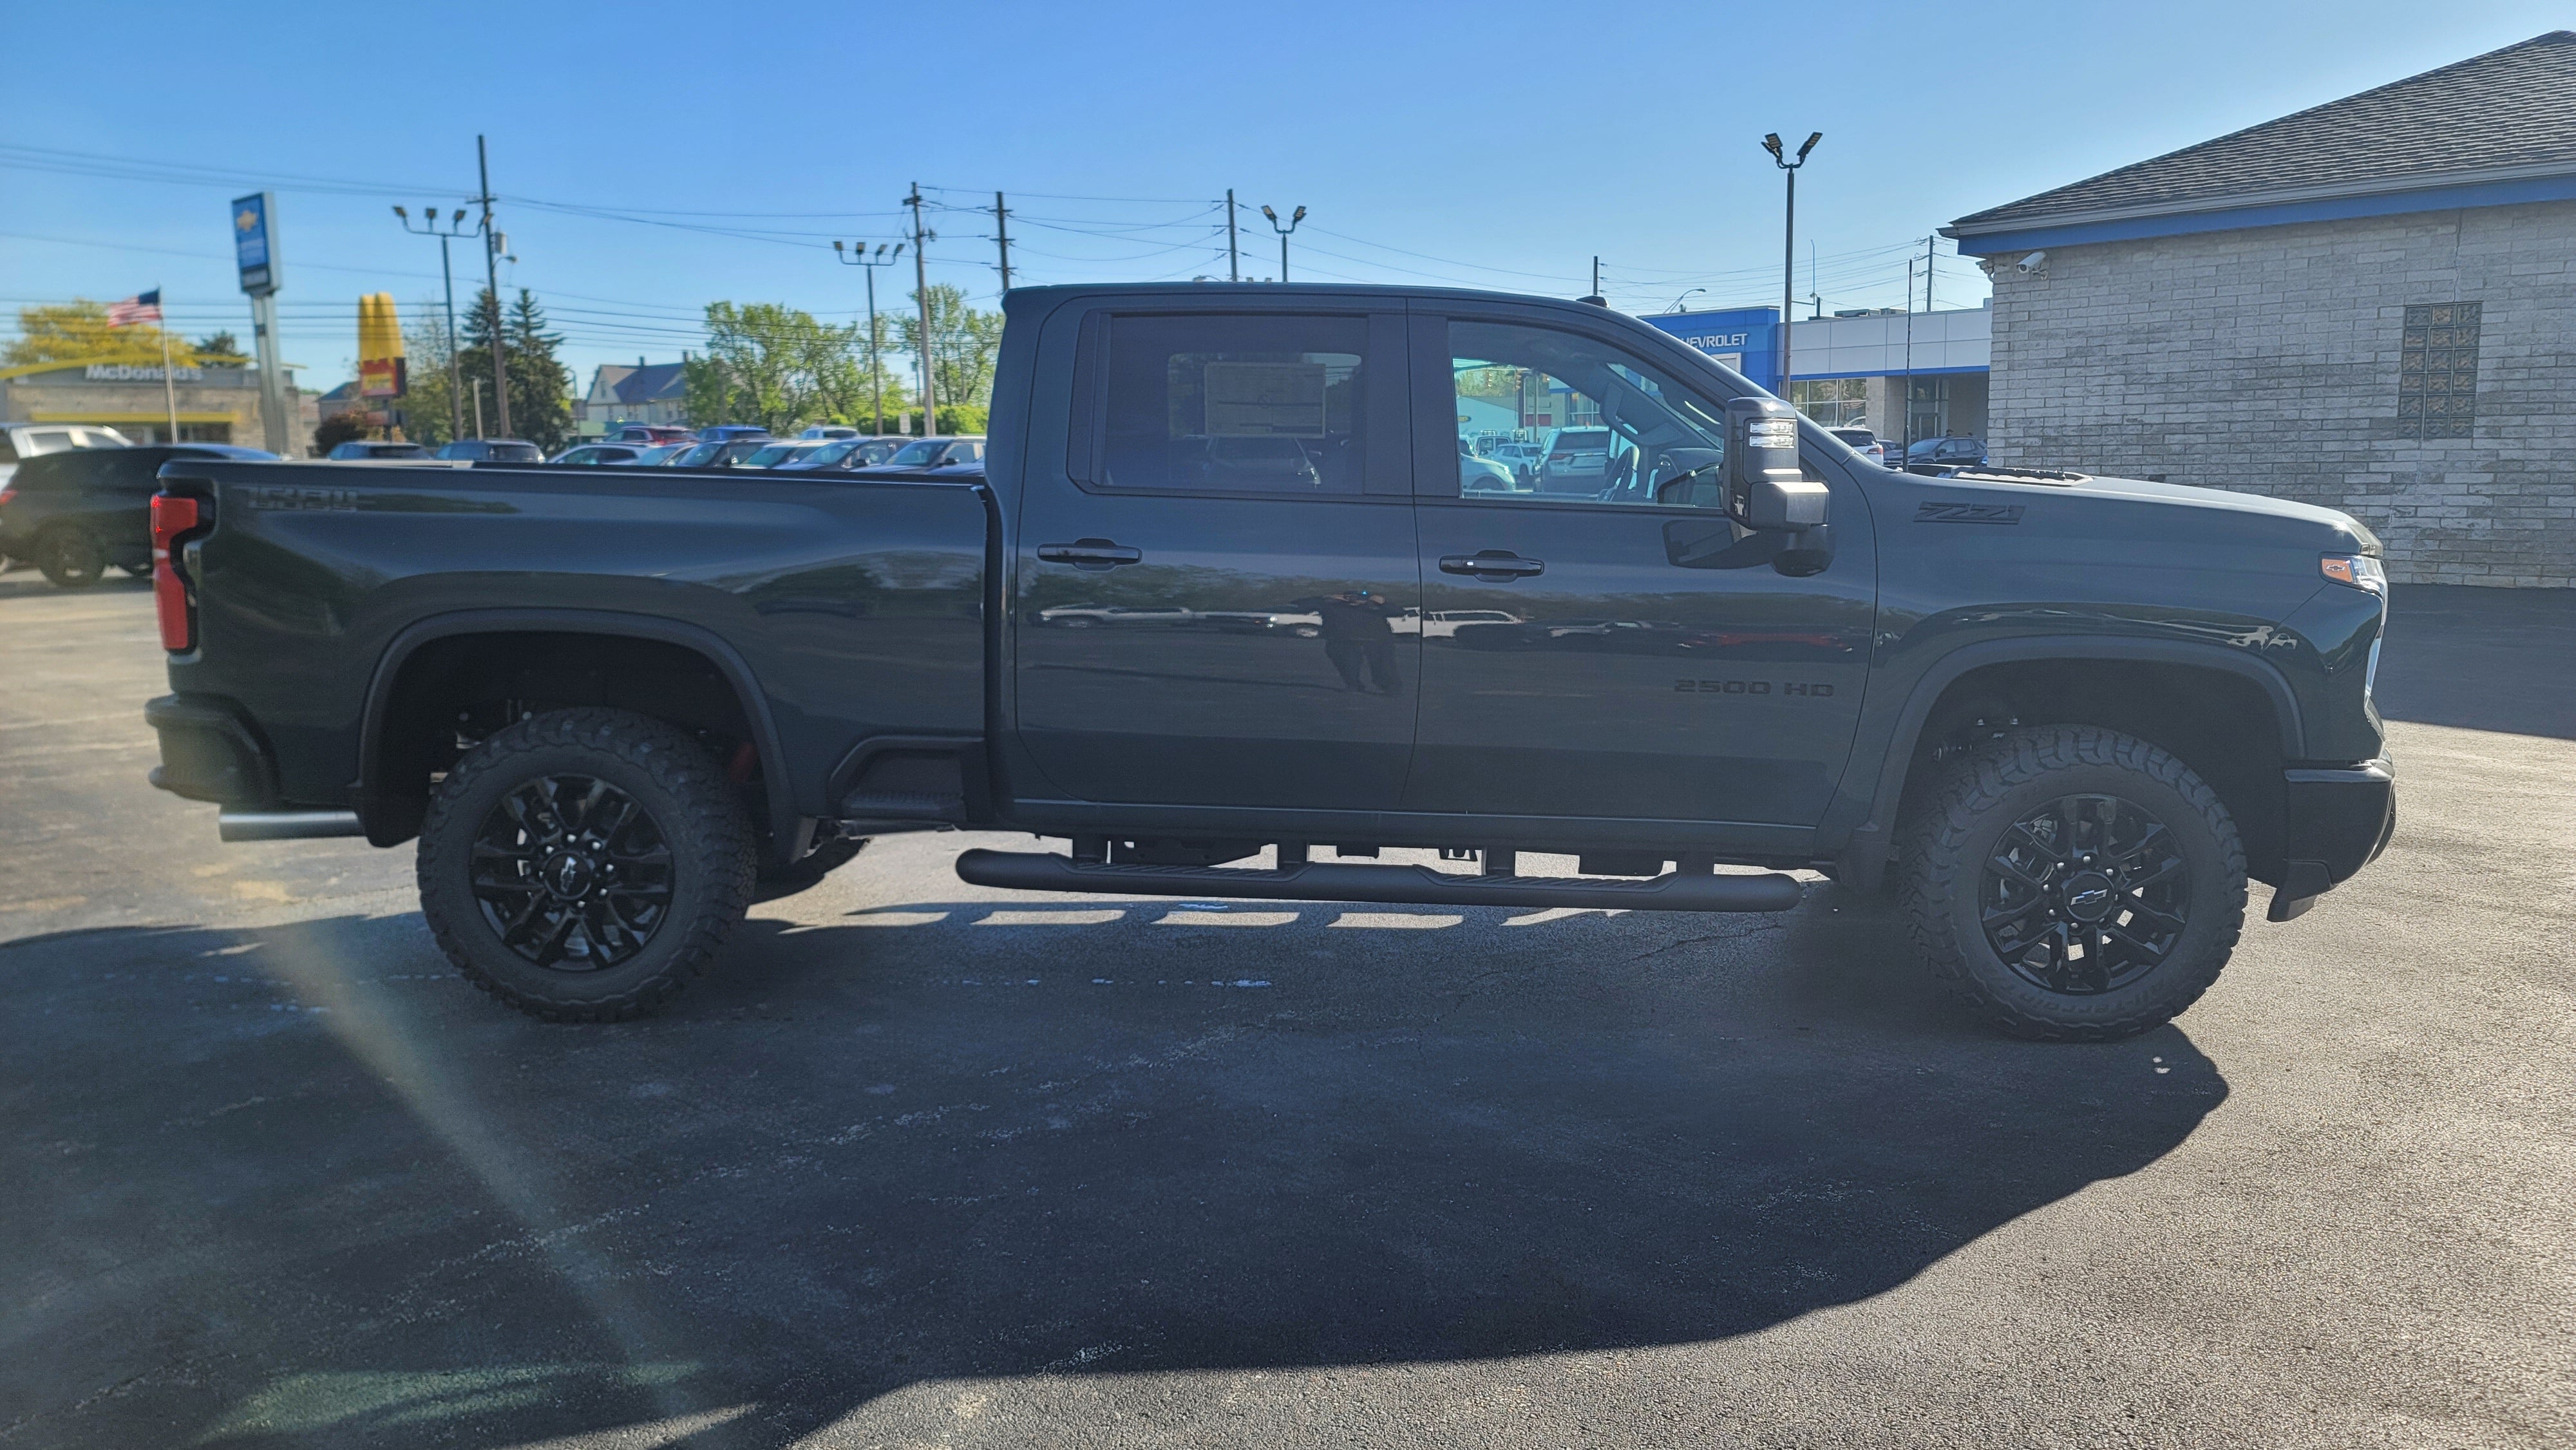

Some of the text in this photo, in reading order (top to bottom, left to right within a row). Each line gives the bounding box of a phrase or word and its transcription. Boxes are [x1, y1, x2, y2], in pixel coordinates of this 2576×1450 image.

[1681, 332, 1748, 348] HEVROLET
[85, 363, 204, 381] McDonalds
[1913, 500, 2027, 525] Z71
[1674, 679, 1835, 696] 2500 HD
